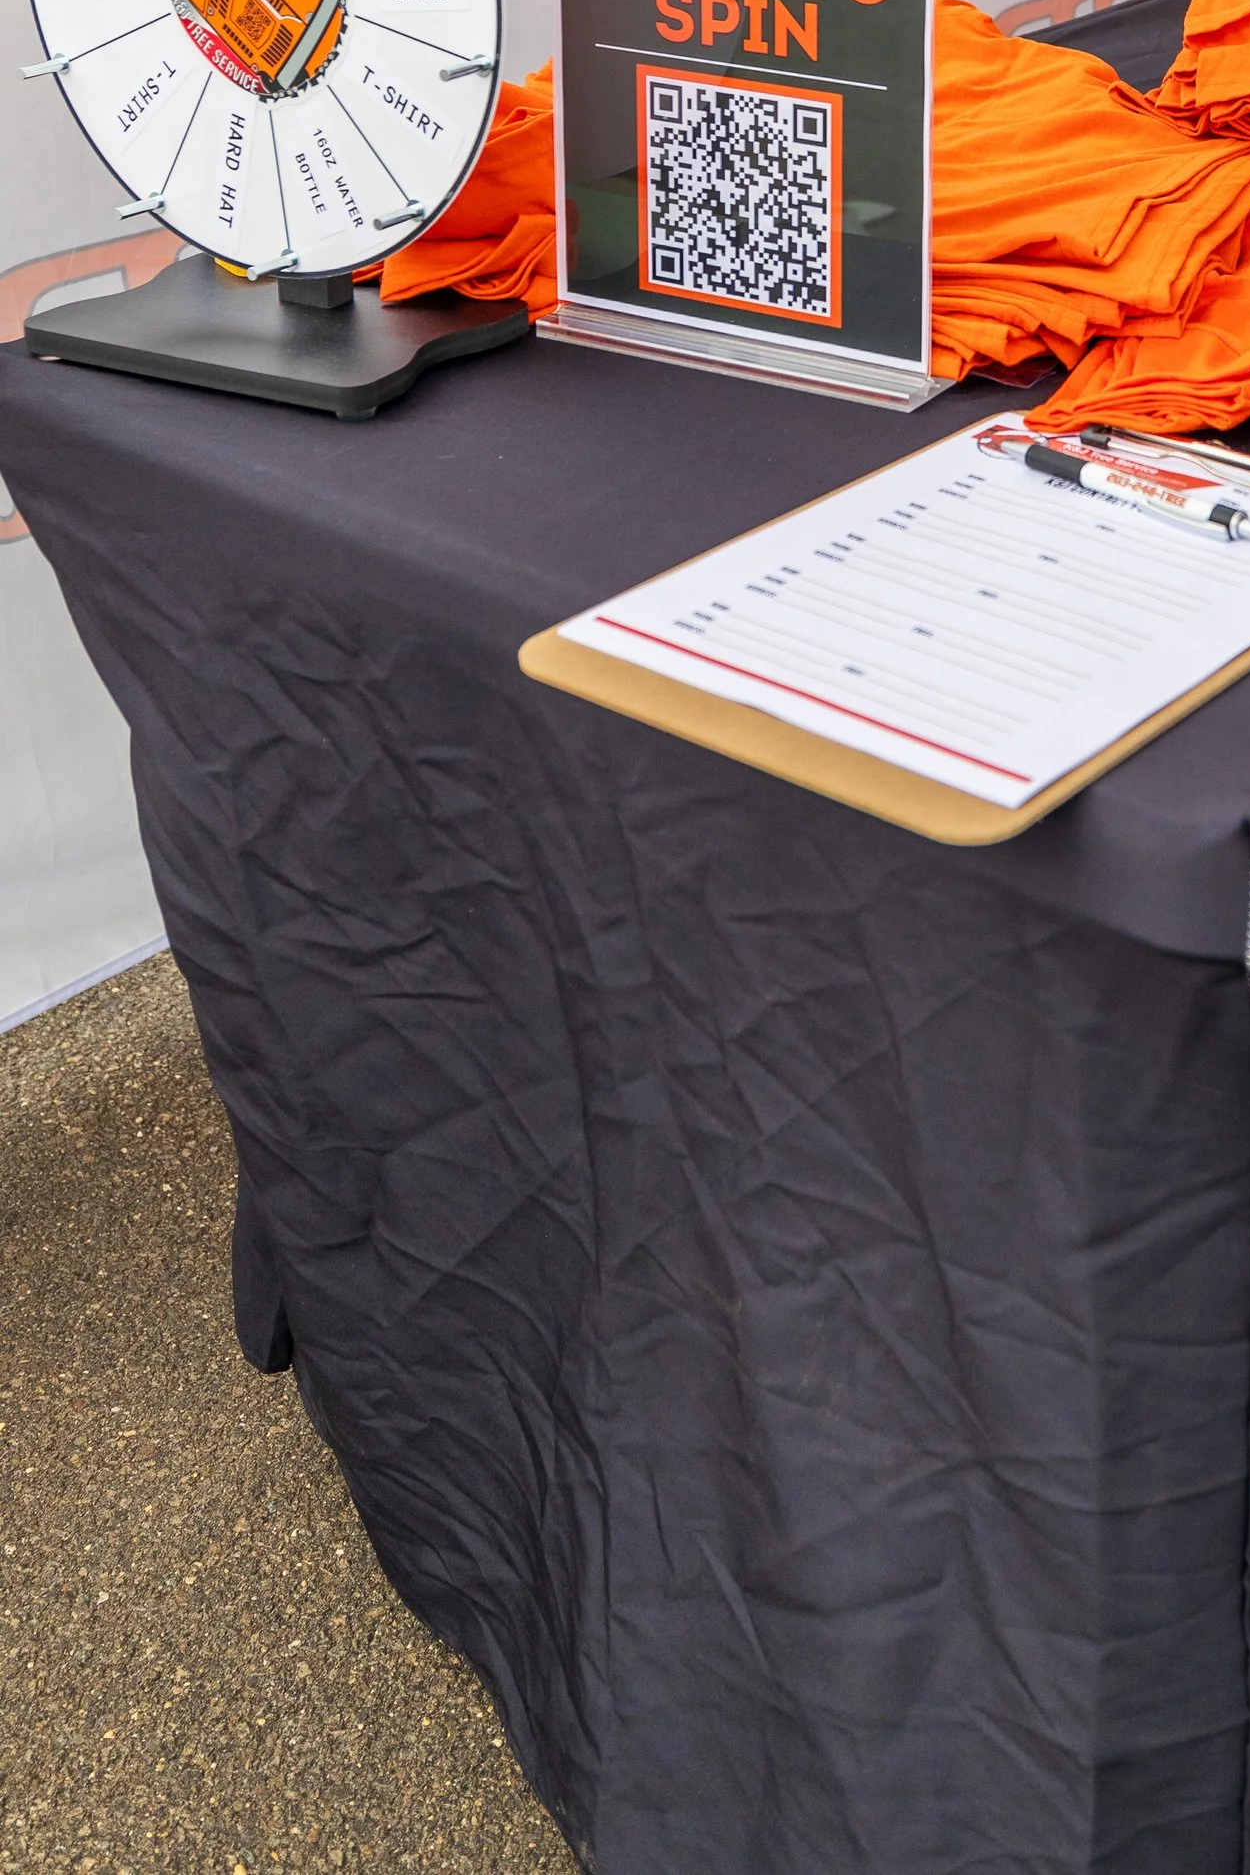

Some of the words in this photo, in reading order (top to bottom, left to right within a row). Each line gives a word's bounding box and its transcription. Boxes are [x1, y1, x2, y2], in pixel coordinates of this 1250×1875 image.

[187, 19, 214, 55] TREE
[211, 48, 260, 94] SERVICE
[117, 60, 177, 133] T-SHIRT
[360, 64, 444, 141] T-SHIRT
[225, 112, 247, 172] HARD
[218, 183, 238, 229] HAT
[295, 152, 328, 215] BOTTLE
[334, 175, 365, 229] WATER
